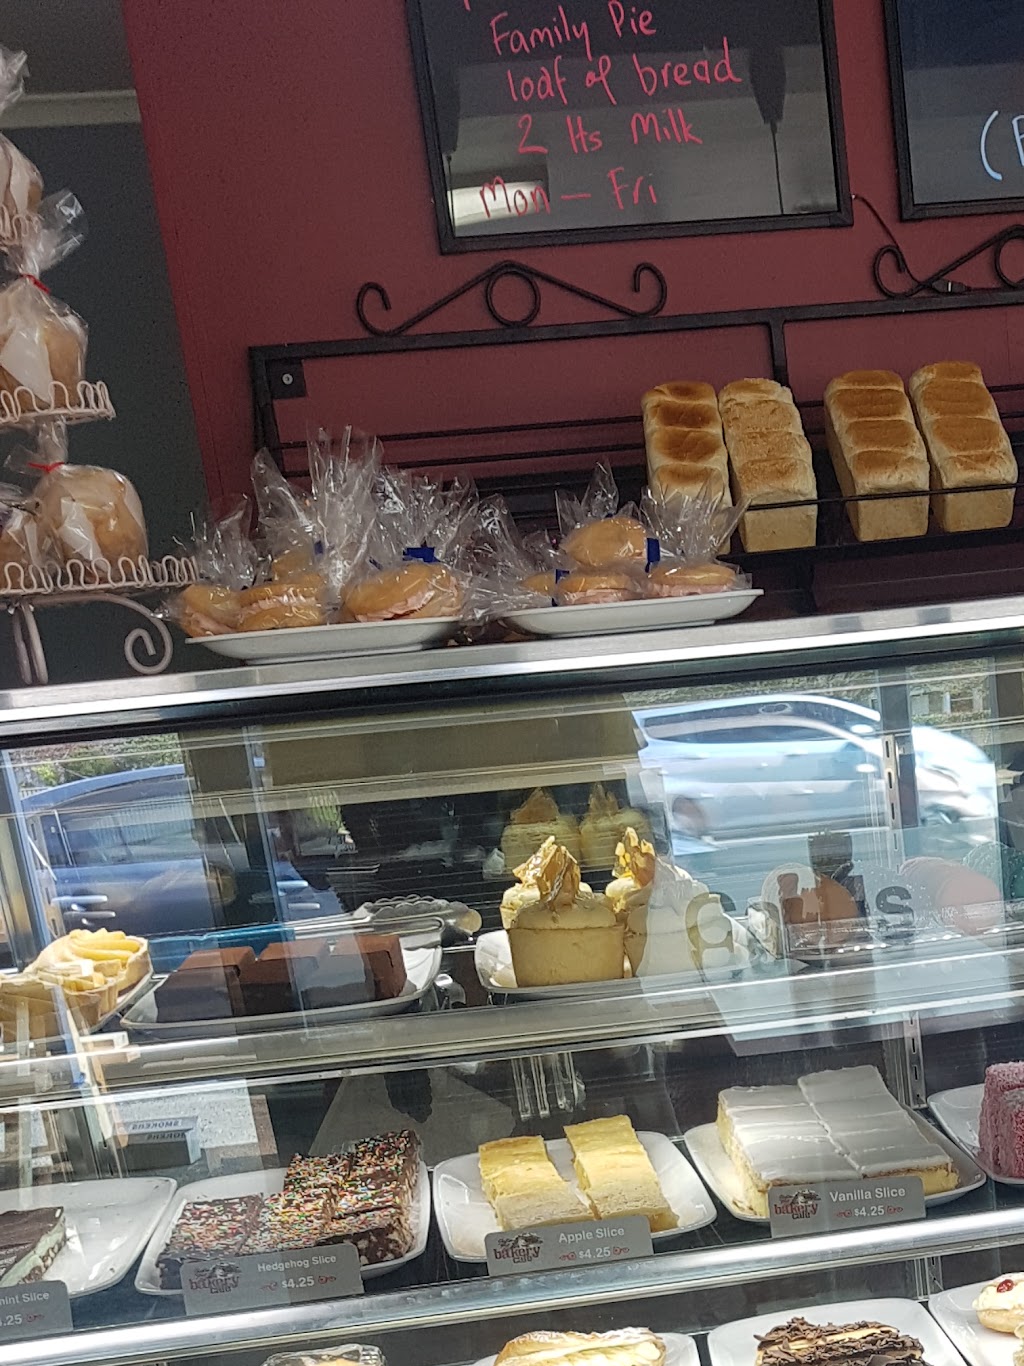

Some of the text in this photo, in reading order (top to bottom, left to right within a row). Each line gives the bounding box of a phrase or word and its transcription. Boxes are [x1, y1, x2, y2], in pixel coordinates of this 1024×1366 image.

[490, 0, 657, 61] Family Pie
[507, 37, 743, 105] loaf of bread
[518, 114, 548, 153] 2
[630, 108, 703, 145] Milk
[479, 176, 551, 218] Mon
[608, 167, 657, 210] Fri
[830, 1187, 905, 1202] Vanilla Slice
[854, 1206, 884, 1217] $4.25
[559, 1227, 625, 1243] Apple Slice
[579, 1247, 610, 1259] $4.25
[258, 1255, 337, 1272] Hedgehog Slice
[282, 1276, 314, 1288] $4.25
[22, 1292, 49, 1302] Slice
[0, 1314, 22, 1326] .25
